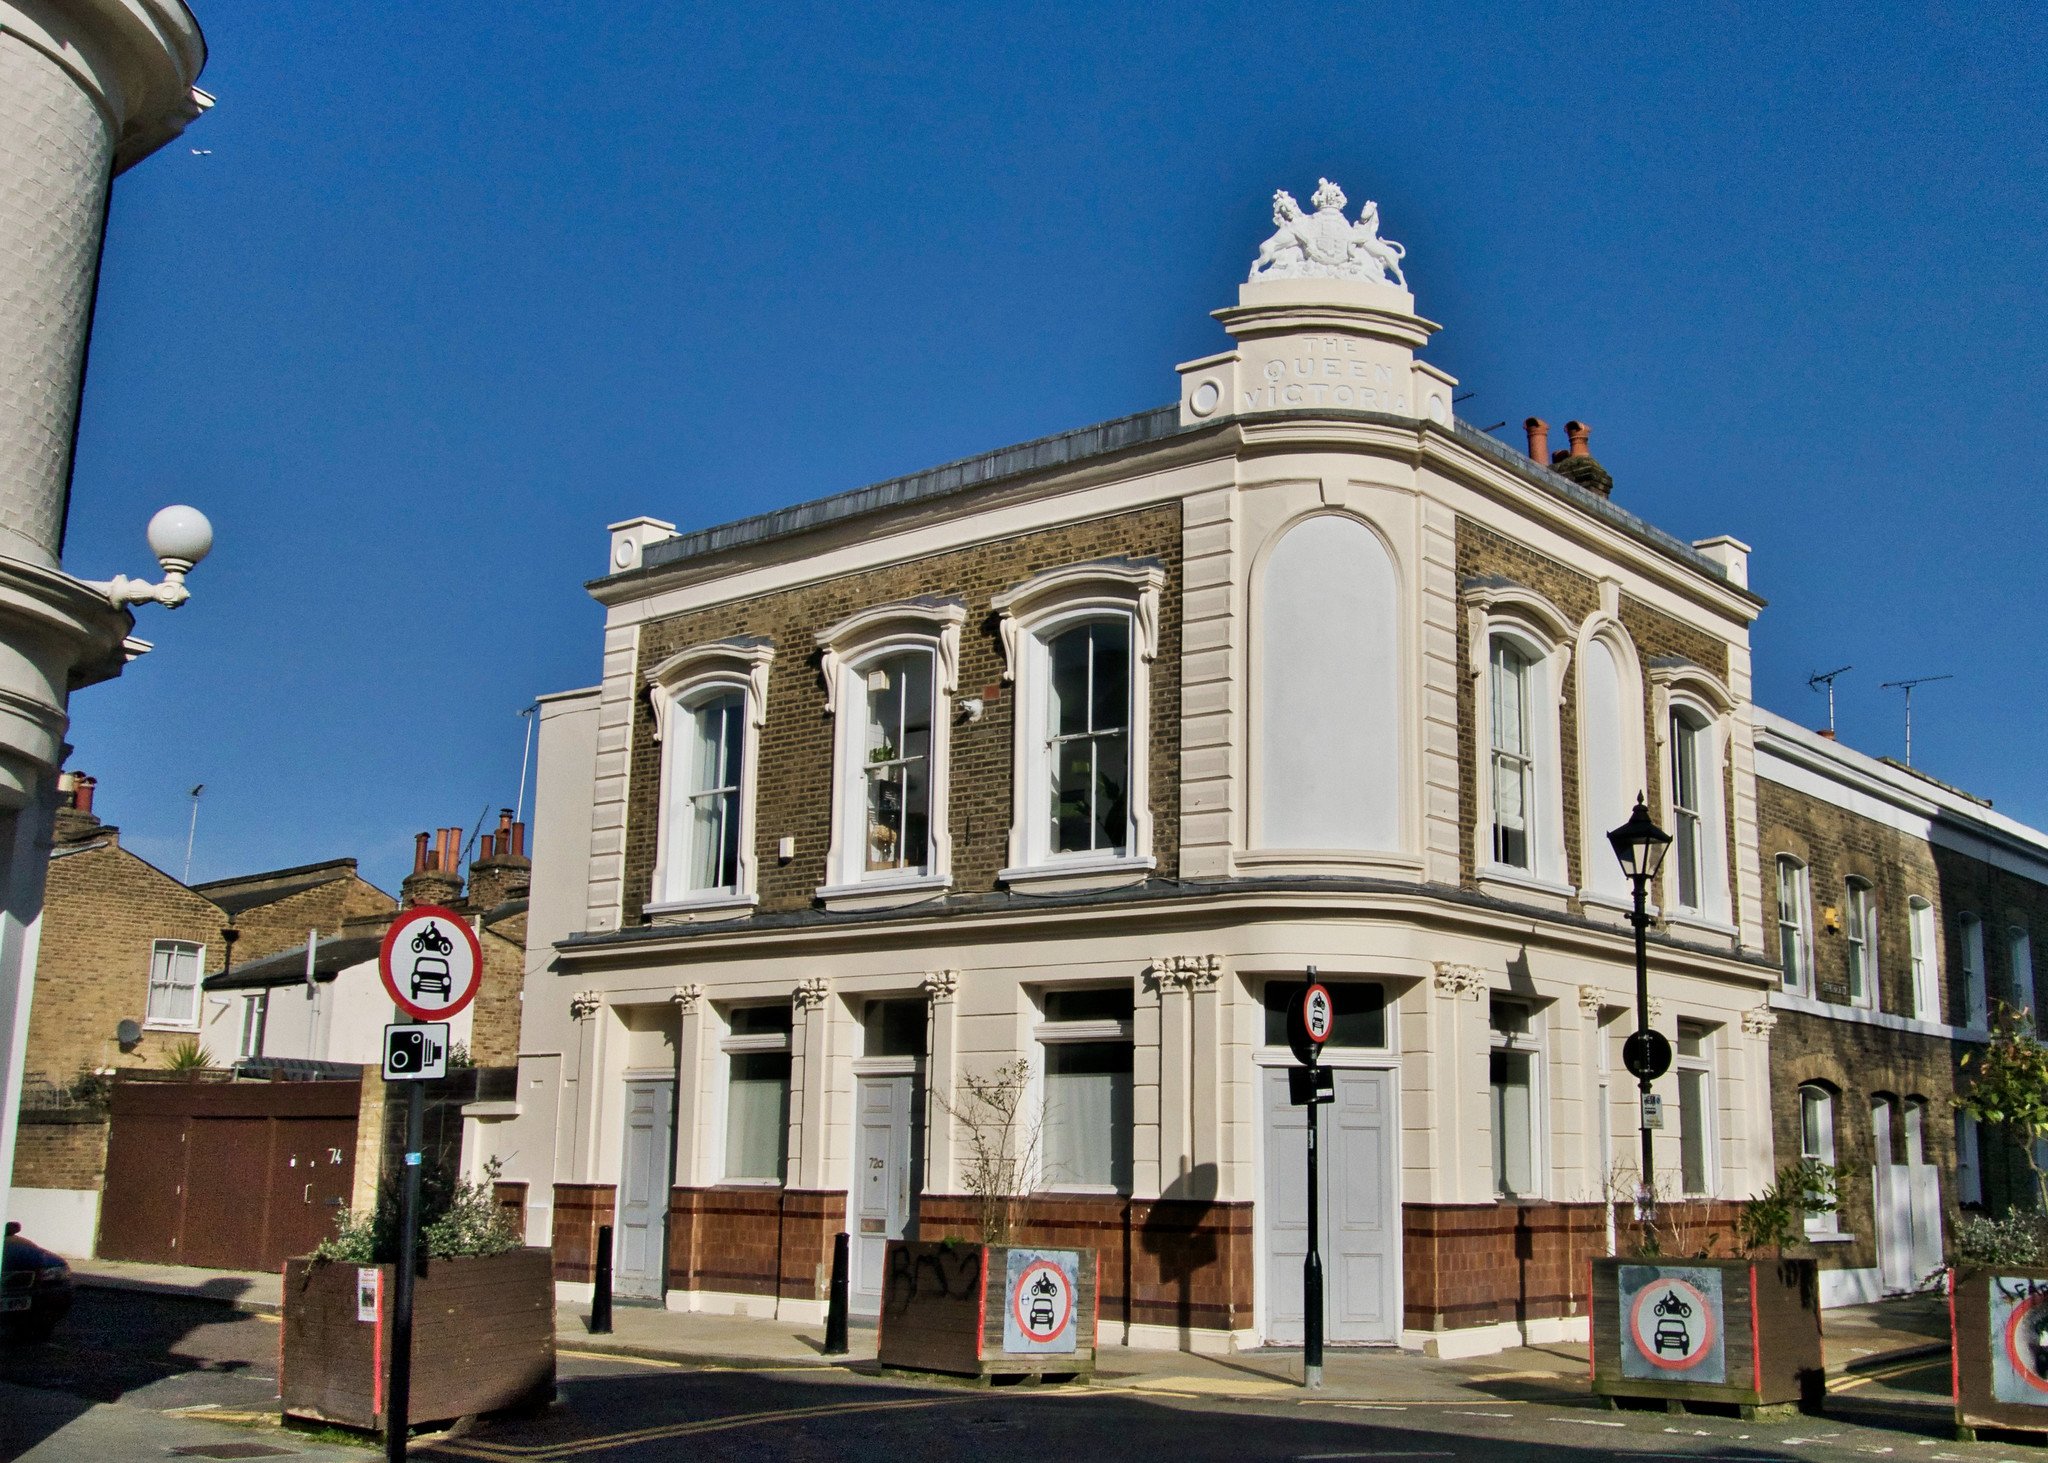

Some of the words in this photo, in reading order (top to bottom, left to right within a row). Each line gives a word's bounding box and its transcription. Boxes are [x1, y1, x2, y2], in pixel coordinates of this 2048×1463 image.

[1303, 337, 1357, 353] THE
[1263, 358, 1393, 385] QUEEN
[1244, 383, 1409, 411] VICTORIA
[328, 1148, 342, 1164] 74
